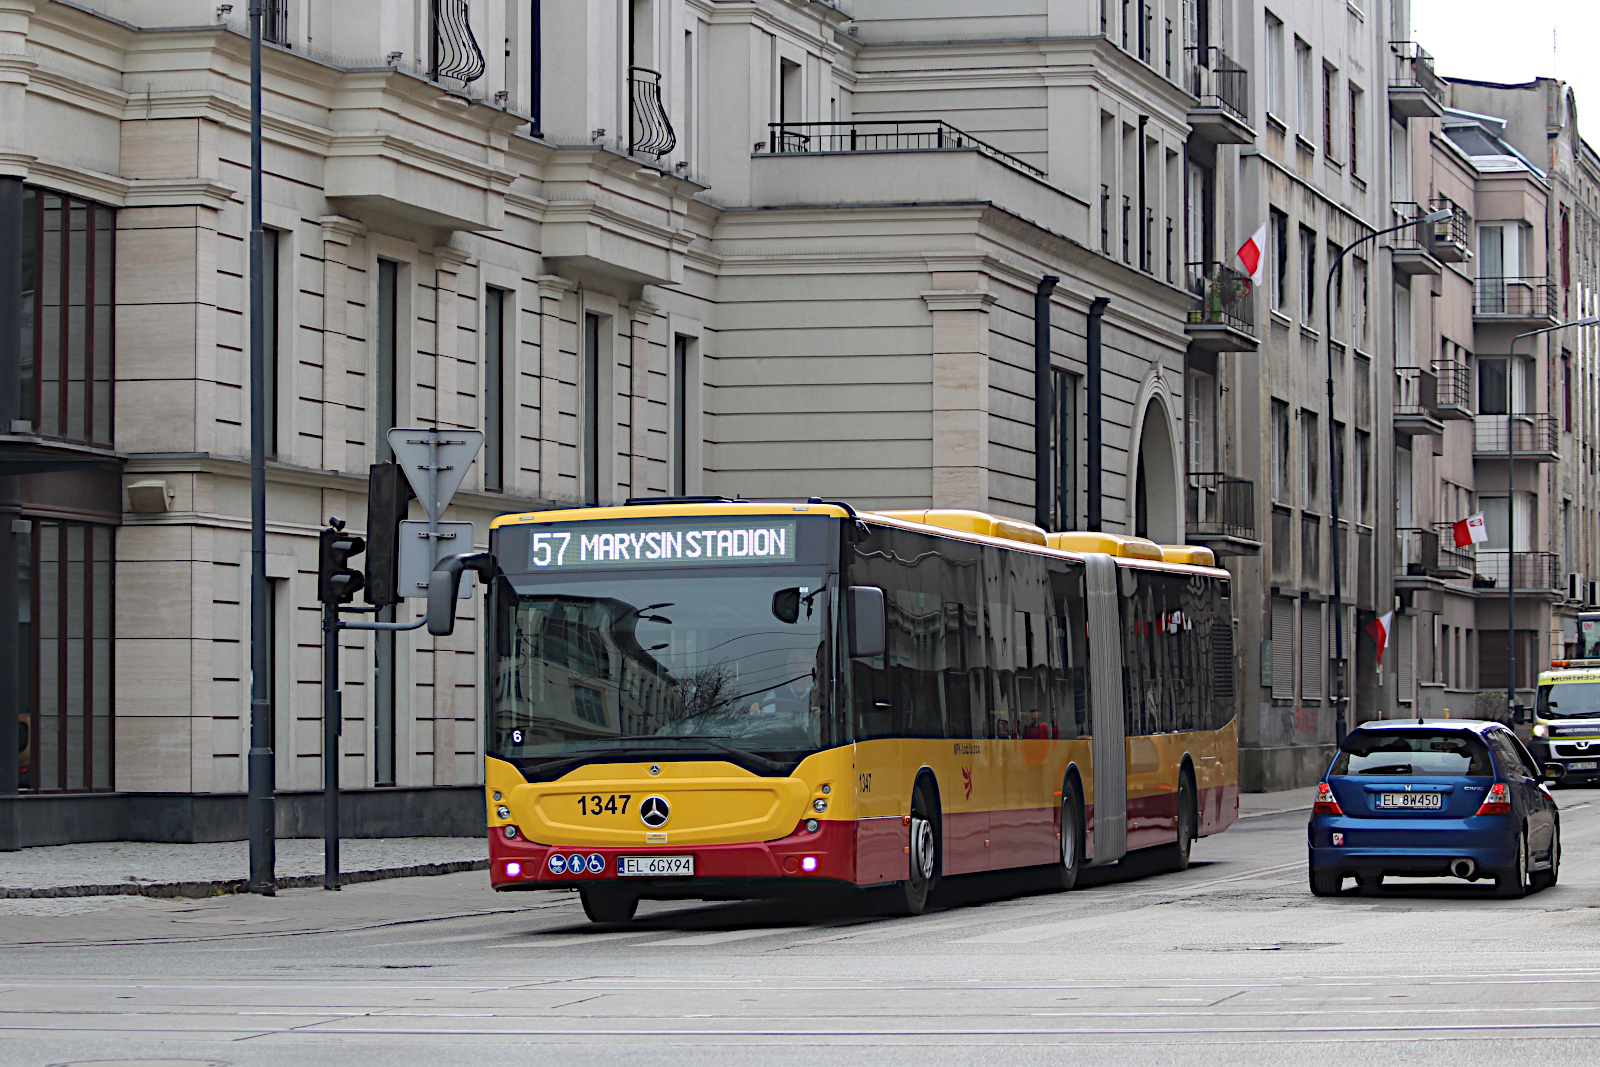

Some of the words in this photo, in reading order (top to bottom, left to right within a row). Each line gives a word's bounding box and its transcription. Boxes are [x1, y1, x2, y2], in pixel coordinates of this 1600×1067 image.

[533, 532, 571, 566] 57
[580, 532, 682, 561] MARYSIN
[685, 528, 786, 558] STADION
[513, 730, 522, 743] 6
[859, 773, 871, 793] 1347
[577, 794, 631, 816] 1347
[1383, 794, 1398, 806] EL
[1402, 794, 1439, 806] 8W450
[627, 859, 643, 872] EL
[649, 859, 690, 872] 6GX94
